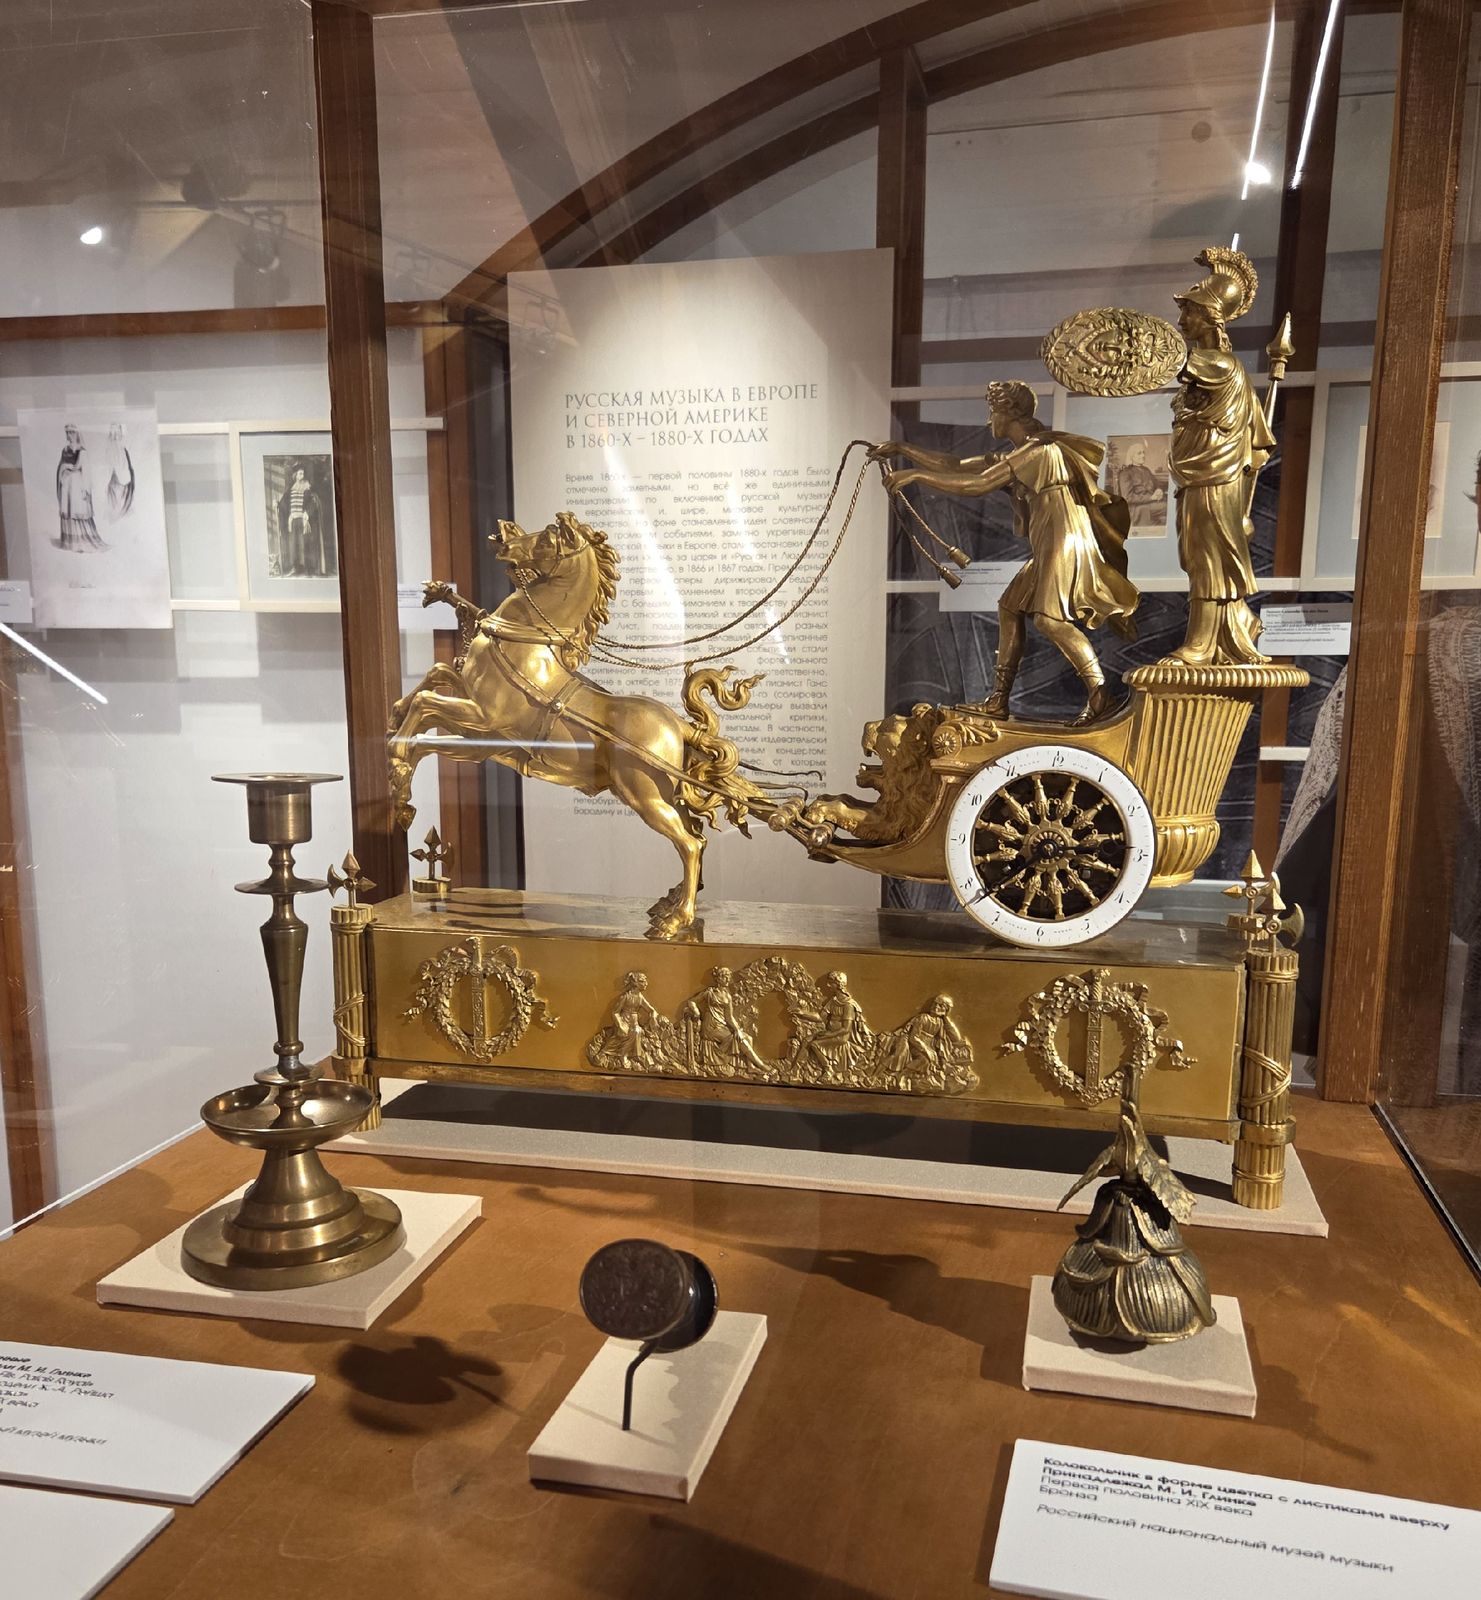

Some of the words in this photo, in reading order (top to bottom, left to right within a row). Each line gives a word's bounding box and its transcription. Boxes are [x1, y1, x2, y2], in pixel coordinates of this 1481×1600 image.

[565, 391, 643, 409] РУССКАЯ
[649, 387, 725, 407] МУЗЫКА
[732, 386, 741, 402] В
[748, 383, 818, 402] ЕВРОПЕ
[565, 414, 577, 429] И
[584, 408, 678, 429] СЕВЕРНОЙ
[684, 406, 769, 425] АМЕРИКЕ
[566, 434, 575, 449] В
[651, 430, 703, 447] 1880-Х
[711, 427, 769, 444] ГОДАХ
[565, 473, 593, 482] Время
[648, 470, 682, 481] первой
[688, 471, 733, 480] половины
[740, 469, 767, 477] 1880-х
[773, 469, 799, 477] годов
[806, 466, 831, 475] было
[566, 486, 608, 494] отмечено
[713, 481, 730, 490] всё
[772, 480, 830, 490] единичными
[673, 495, 725, 503] включению
[741, 492, 780, 503] русской
[681, 506, 709, 516] шире,
[653, 518, 676, 529] фоне
[772, 516, 829, 525] славянскоо
[664, 529, 714, 539] событиями,
[684, 541, 719, 552] Европе,
[731, 551, 767, 562] «Русан
[688, 564, 706, 573] 1866
[718, 563, 736, 573] 1867
[673, 577, 703, 586] оперы
[714, 575, 777, 585] дирижировал
[735, 586, 767, 596] второй
[798, 585, 829, 594] Млий
[616, 622, 640, 632] Лист,
[795, 622, 829, 632] разных
[802, 643, 828, 651] стали
[757, 656, 828, 667] фортеианного
[625, 676, 659, 689] октябре
[766, 678, 803, 688] пианист
[806, 677, 828, 687] Ганс
[773, 688, 828, 700] (солировал
[790, 701, 828, 711] вызвали
[789, 713, 828, 723] критики,
[725, 724, 761, 734] выпады.
[767, 723, 773, 732] В
[778, 724, 828, 736] частности,
[761, 736, 828, 746] издевательски
[775, 747, 827, 757] концертом:
[791, 758, 827, 768] которых
[1051, 752, 1065, 768] 12
[969, 793, 983, 807] 10
[574, 806, 615, 818] Бородину
[1127, 804, 1137, 817] 2
[956, 832, 967, 846] 9
[1132, 849, 1143, 864] 3
[1113, 890, 1125, 904] 4
[991, 911, 1001, 925] 7
[1035, 925, 1045, 939] 6
[1039, 1484, 1098, 1502] Бронза
[1042, 1466, 1152, 1490] Принадлежал
[1157, 1485, 1176, 1494] М.
[1181, 1487, 1197, 1498] И.
[1201, 1492, 1257, 1507] Глинке
[1040, 1475, 1099, 1491] Первая
[1103, 1486, 1181, 1505] половина
[1213, 1504, 1253, 1517] века
[1043, 1456, 1140, 1479] Колокольчик
[1144, 1473, 1154, 1481] в
[1157, 1476, 1213, 1490] форме
[1217, 1486, 1273, 1501] цветка
[1278, 1495, 1289, 1503] с
[1293, 1498, 1386, 1520] листиками
[1389, 1514, 1450, 1531] вверху
[1037, 1503, 1138, 1528] Российский
[1140, 1522, 1268, 1550] национальный
[1271, 1544, 1326, 1561] музей
[1330, 1555, 1394, 1573] музыки
